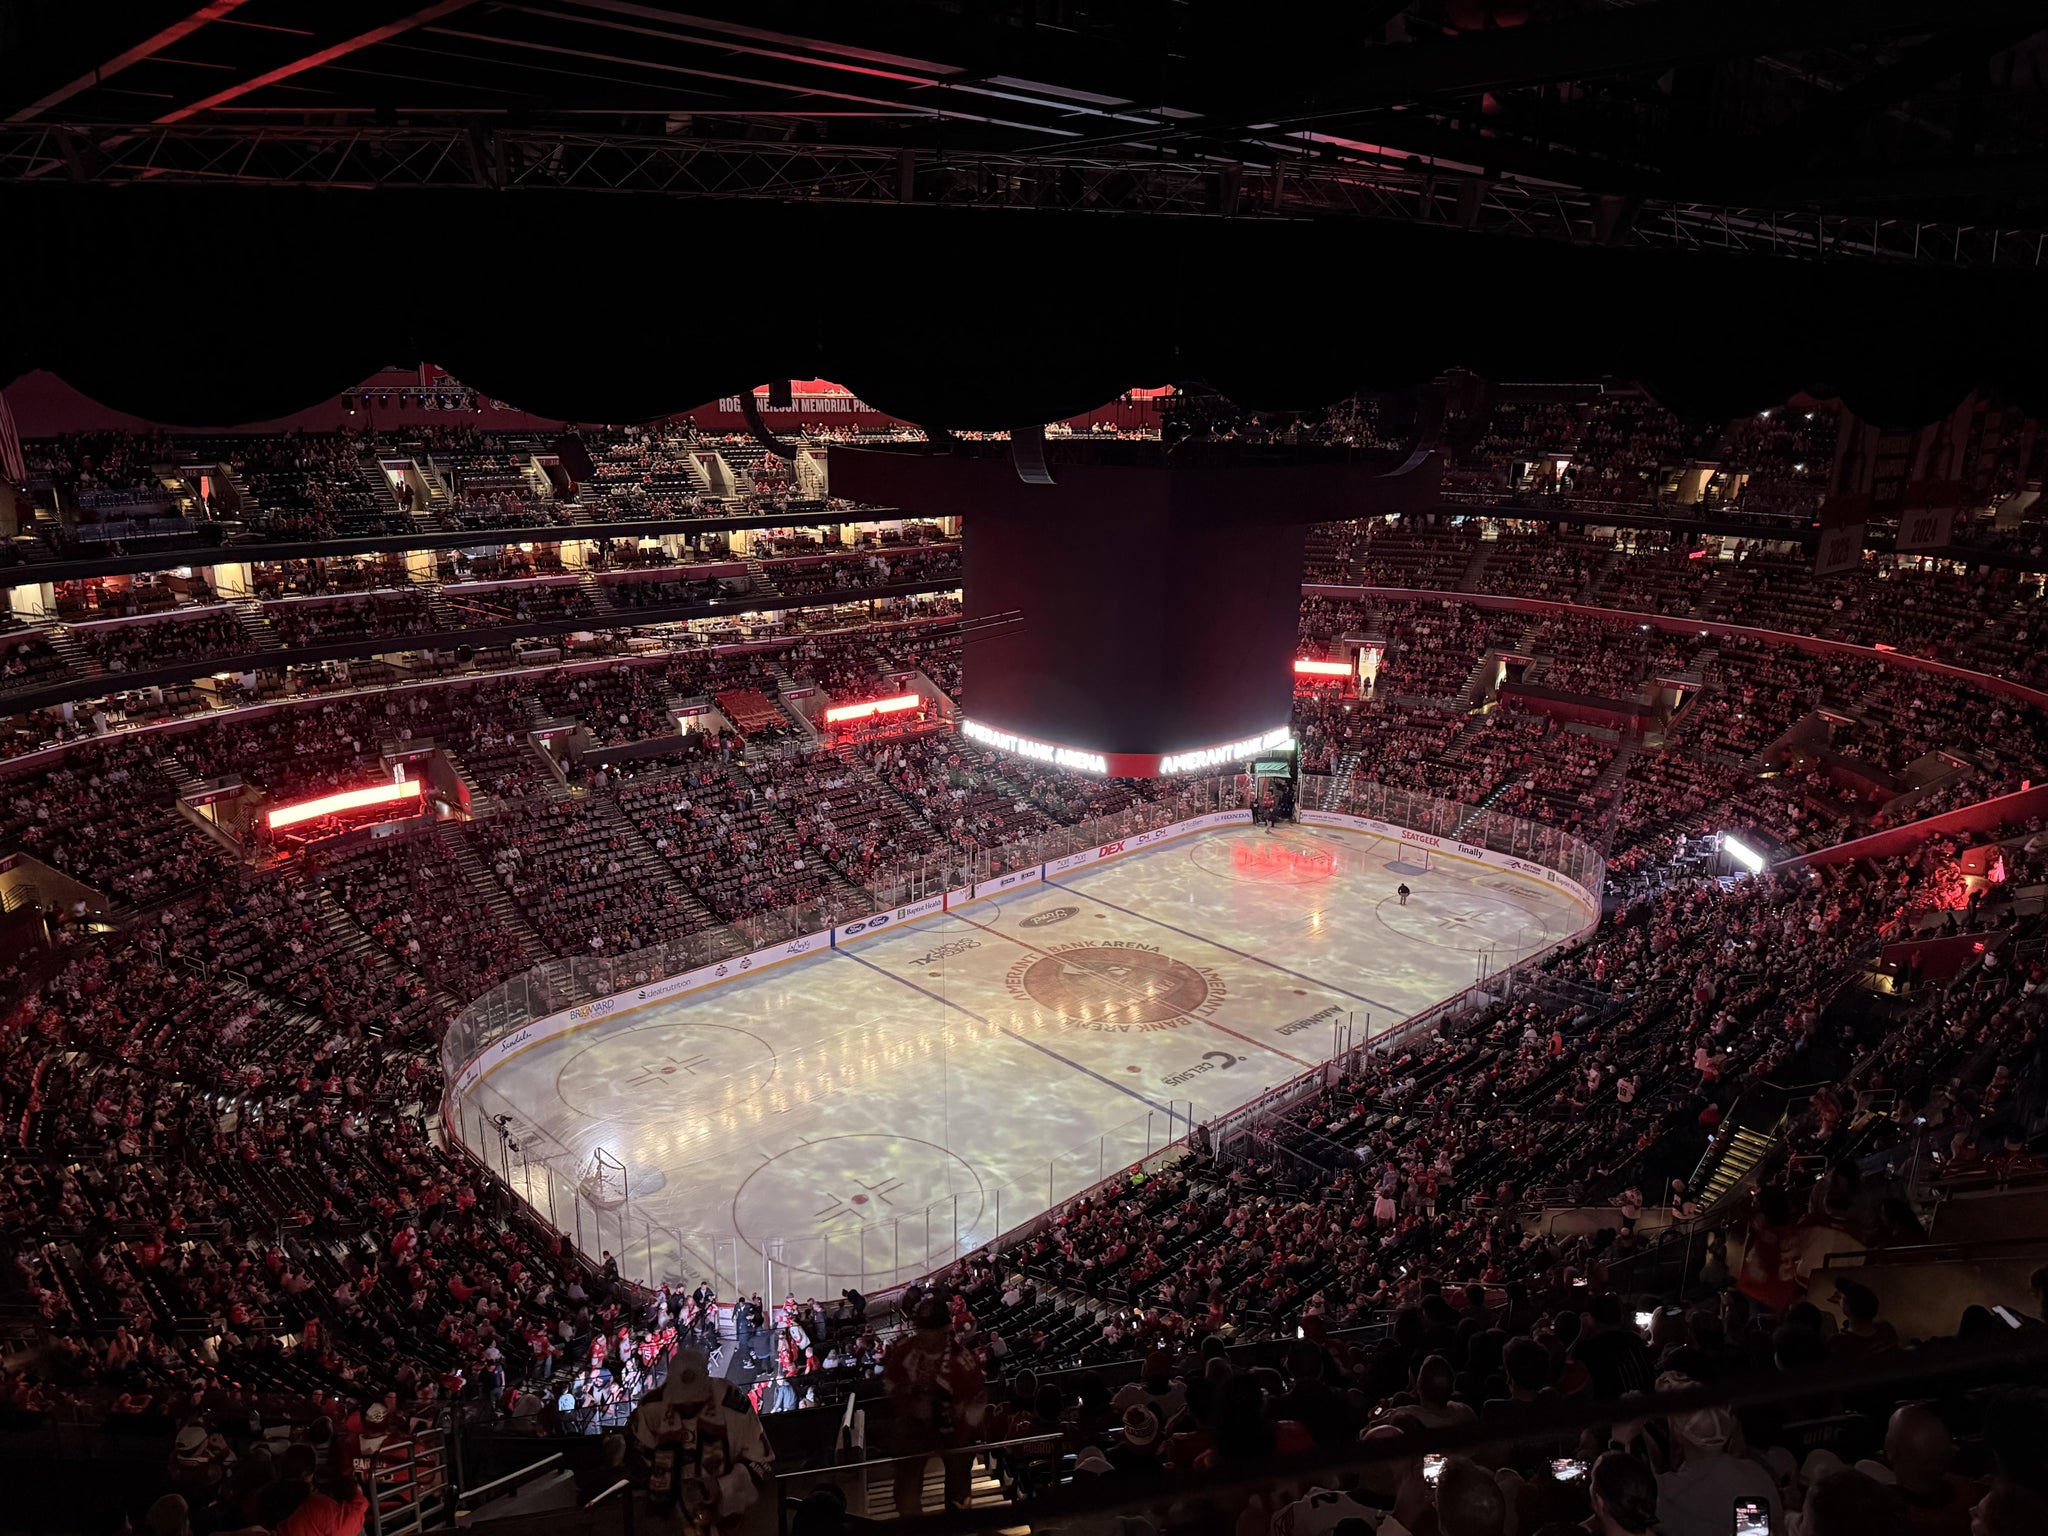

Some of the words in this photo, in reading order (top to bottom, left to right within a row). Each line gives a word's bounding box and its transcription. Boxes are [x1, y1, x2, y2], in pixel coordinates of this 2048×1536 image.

[801, 398, 852, 412] MEMORIAL
[853, 399, 880, 412] PRE
[1910, 518, 1938, 543] 2024
[962, 719, 1018, 753] AMERANT
[1018, 739, 1054, 763] BANK
[1055, 747, 1108, 773] ARENA
[1159, 744, 1234, 774] AMERANT
[1221, 812, 1250, 821] HONDA
[1098, 841, 1126, 858] DEX
[1401, 830, 1440, 848] SEATGEEK
[1458, 844, 1483, 859] finally
[906, 903, 924, 917] Baptist
[925, 899, 941, 911] Health
[1004, 953, 1040, 1001] AMERANT
[1048, 940, 1096, 957] BANK
[1101, 940, 1161, 953] ARENA
[1195, 967, 1228, 1017] AMERANT
[1139, 1016, 1193, 1033] BANK
[1277, 1004, 1345, 1036] AutoNation
[501, 1030, 532, 1053] Sandals
[1165, 1062, 1215, 1087] CELSIUS
